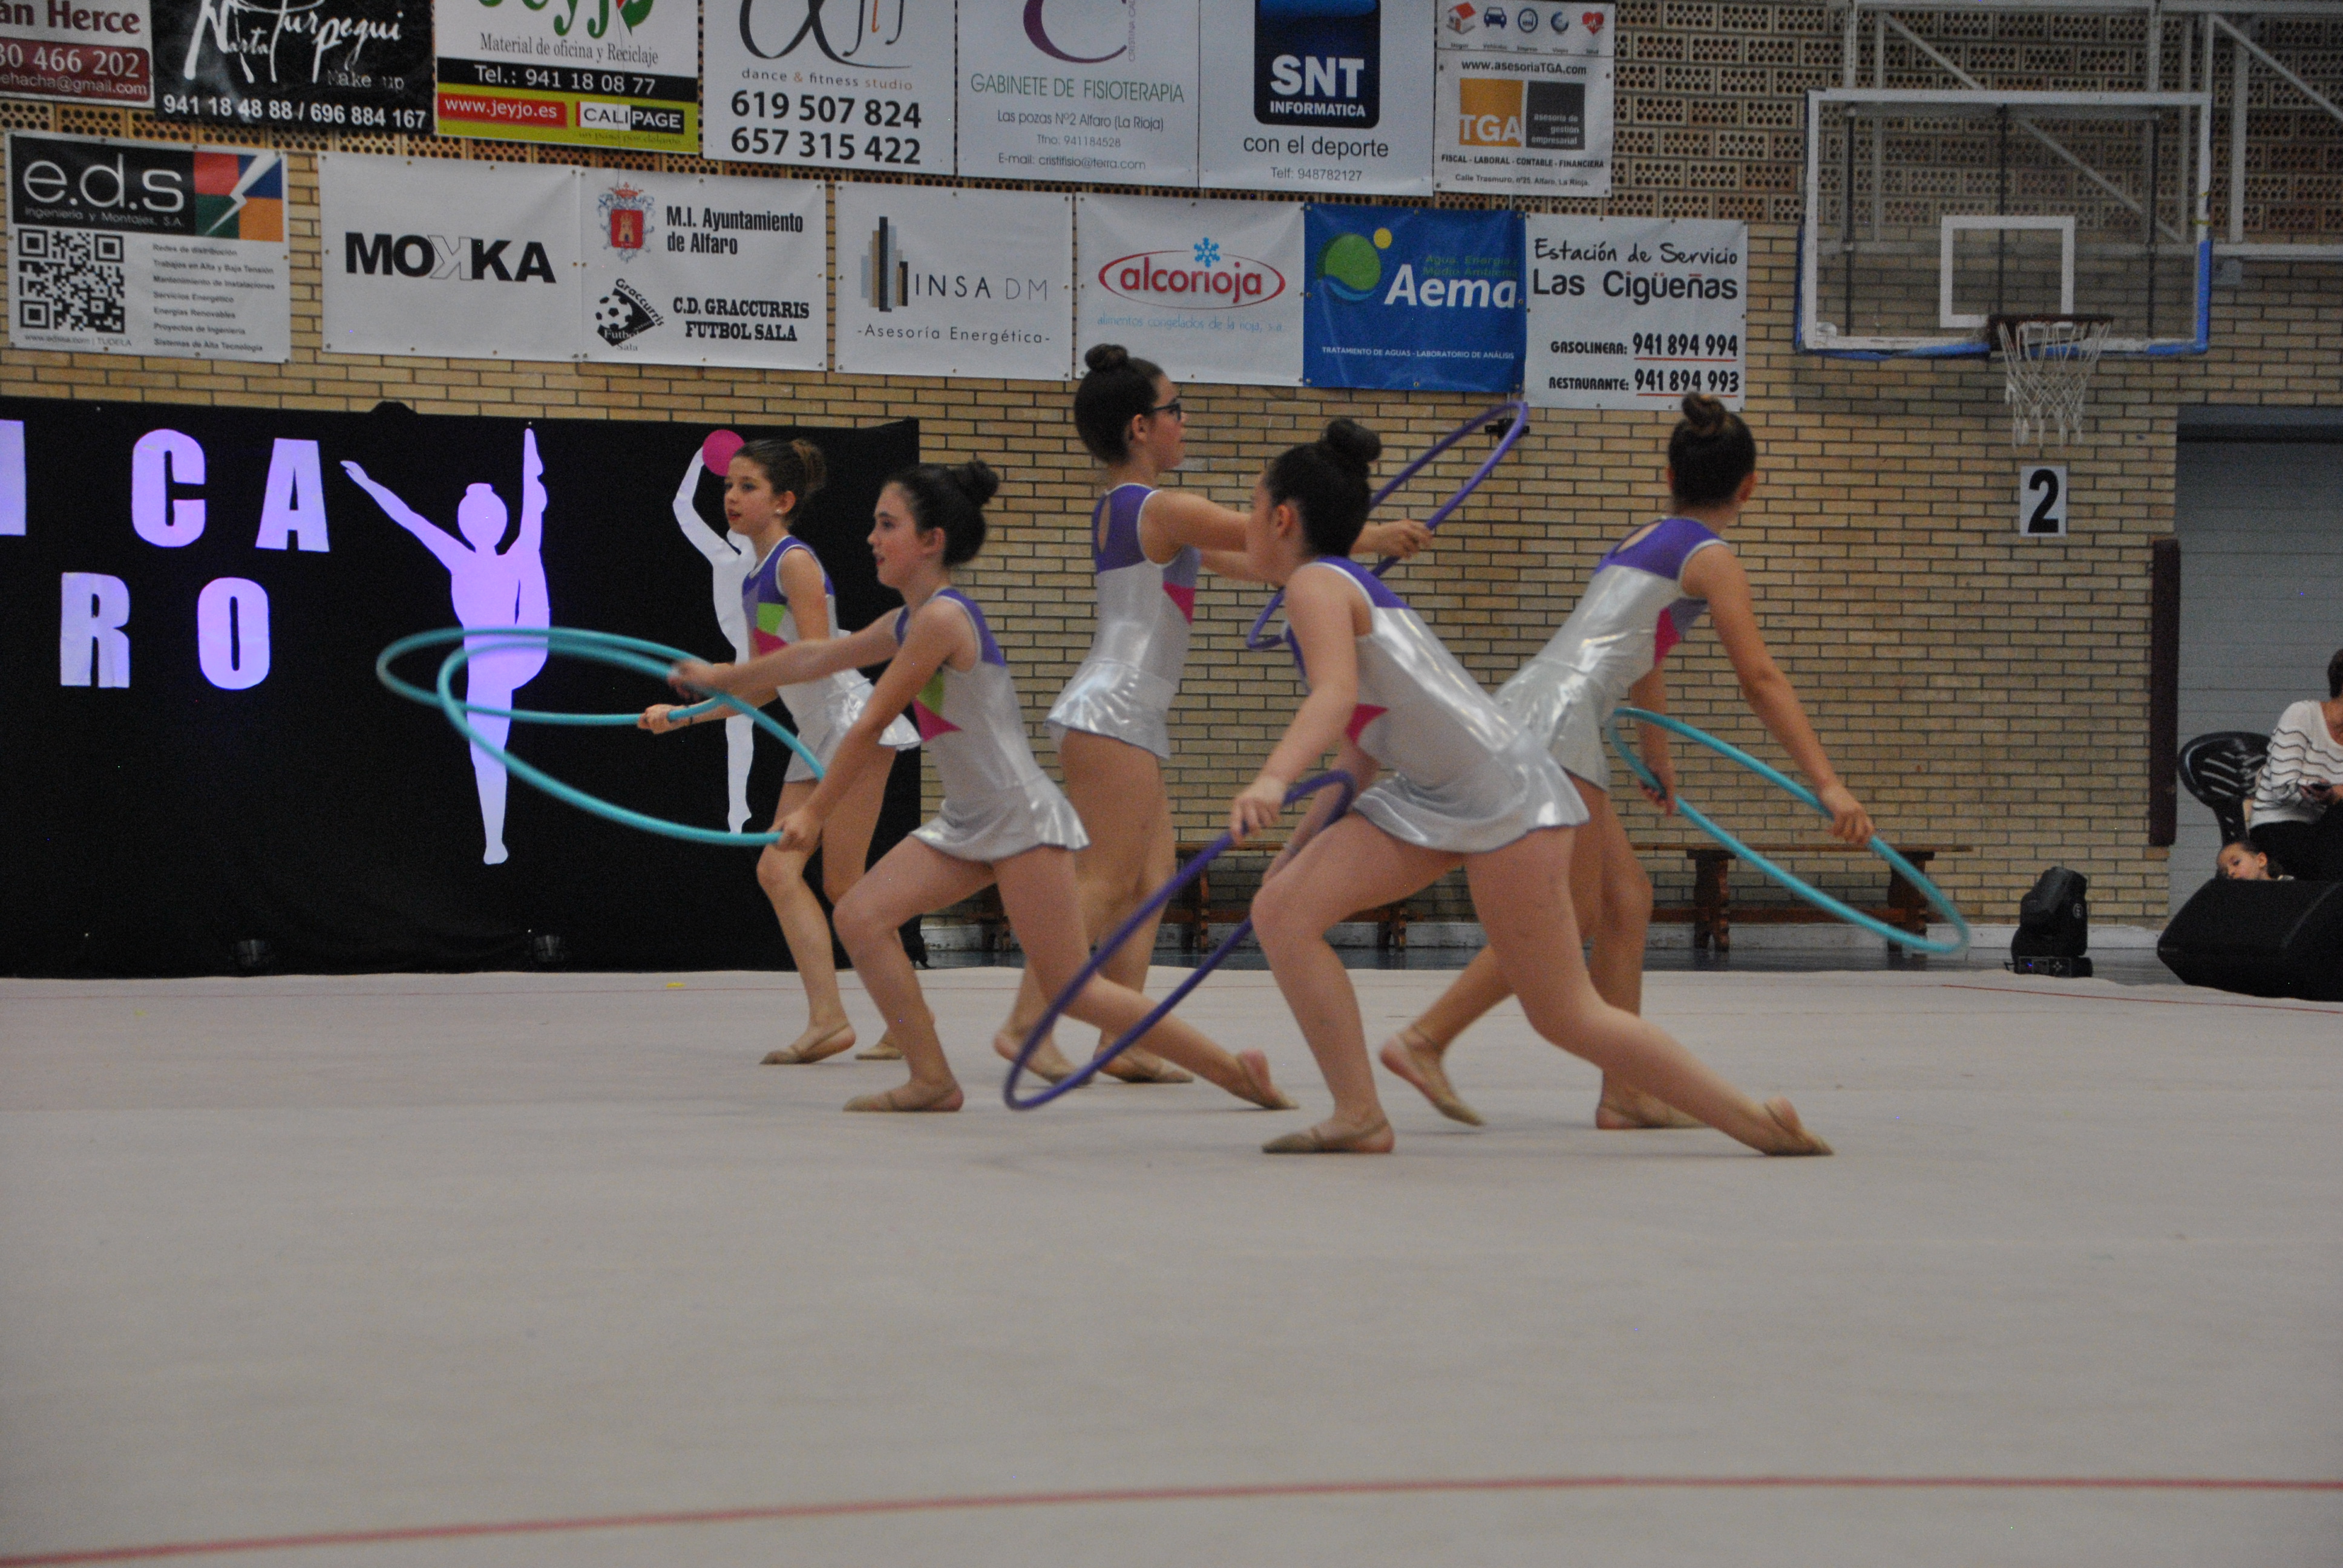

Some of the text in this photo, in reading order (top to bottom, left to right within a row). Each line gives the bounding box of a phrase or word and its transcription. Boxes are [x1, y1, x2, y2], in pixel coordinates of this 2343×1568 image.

[48, 0, 140, 34] Herce
[480, 32, 658, 68] Material de oficina y Reciclaje
[33, 47, 139, 78] 466 202
[1461, 60, 1587, 75] www.asesoriaTGA.com
[474, 65, 655, 95] Tel.: 941 18 08 77
[742, 68, 913, 90] dance & fitness studio
[971, 73, 1185, 103] GABINETE DE FISIOTERAPIA
[1271, 54, 1365, 98] SNT
[163, 94, 199, 114] 941
[209, 97, 232, 116] 18
[238, 97, 263, 118] 48
[269, 100, 293, 120] 88
[310, 103, 346, 123] 696
[351, 105, 386, 126] 884
[393, 109, 426, 128] 167
[445, 98, 557, 119] www.jeyjo.es
[731, 90, 921, 128] 619 507 824
[998, 109, 1015, 122] Las
[1018, 113, 1052, 125] pozas
[1080, 114, 1111, 128] Alfaro
[1115, 116, 1130, 129] (La
[1133, 116, 1164, 132] Rioja)
[1270, 100, 1366, 117] INFORMATICA
[1459, 114, 1522, 142] TGA
[731, 126, 921, 165] 657 315 422
[1064, 135, 1121, 148] 941184528
[1244, 136, 1389, 160] con el deporte
[1531, 136, 1577, 145] empresarial
[998, 152, 1145, 170] E-mail: cristifisio@terra.com
[1441, 154, 1467, 163] FISCAL
[1474, 156, 1510, 165] LABORAL
[1516, 158, 1553, 166] CONTABLE
[24, 152, 184, 212] e.d.s
[1298, 168, 1362, 181] 948782127
[90, 212, 96, 221] y
[666, 206, 804, 232] M.I. Ayuntamiento
[152, 243, 177, 252] Redes
[180, 244, 189, 253] de
[667, 231, 738, 254] de Alfaro
[1535, 238, 1738, 265] Estación de Servicio
[200, 262, 215, 270] Alta
[224, 264, 242, 272] Baja
[916, 273, 1047, 301] INSA DM
[1120, 256, 1262, 303] alcorioja
[1384, 264, 1517, 309] Aema
[1533, 268, 1738, 305] Las Cigüeñas
[615, 278, 664, 326] Graccurris
[673, 297, 810, 319] C.D. GRACCURRIS
[686, 320, 797, 341] FUTBOL SALA
[1097, 312, 1144, 327] alimentos
[1147, 313, 1204, 330] congelados
[1208, 315, 1222, 330] de
[1227, 316, 1235, 330] la
[204, 340, 219, 349] Alta
[1322, 347, 1371, 356] TRATAMIENTO
[1483, 350, 1514, 359] ANÁLISIS
[1550, 332, 1738, 356] GASOLINERA: 941 894 994
[1548, 368, 1739, 393] RESTAURANTE: 941 894 993
[2027, 468, 2060, 534] 2
